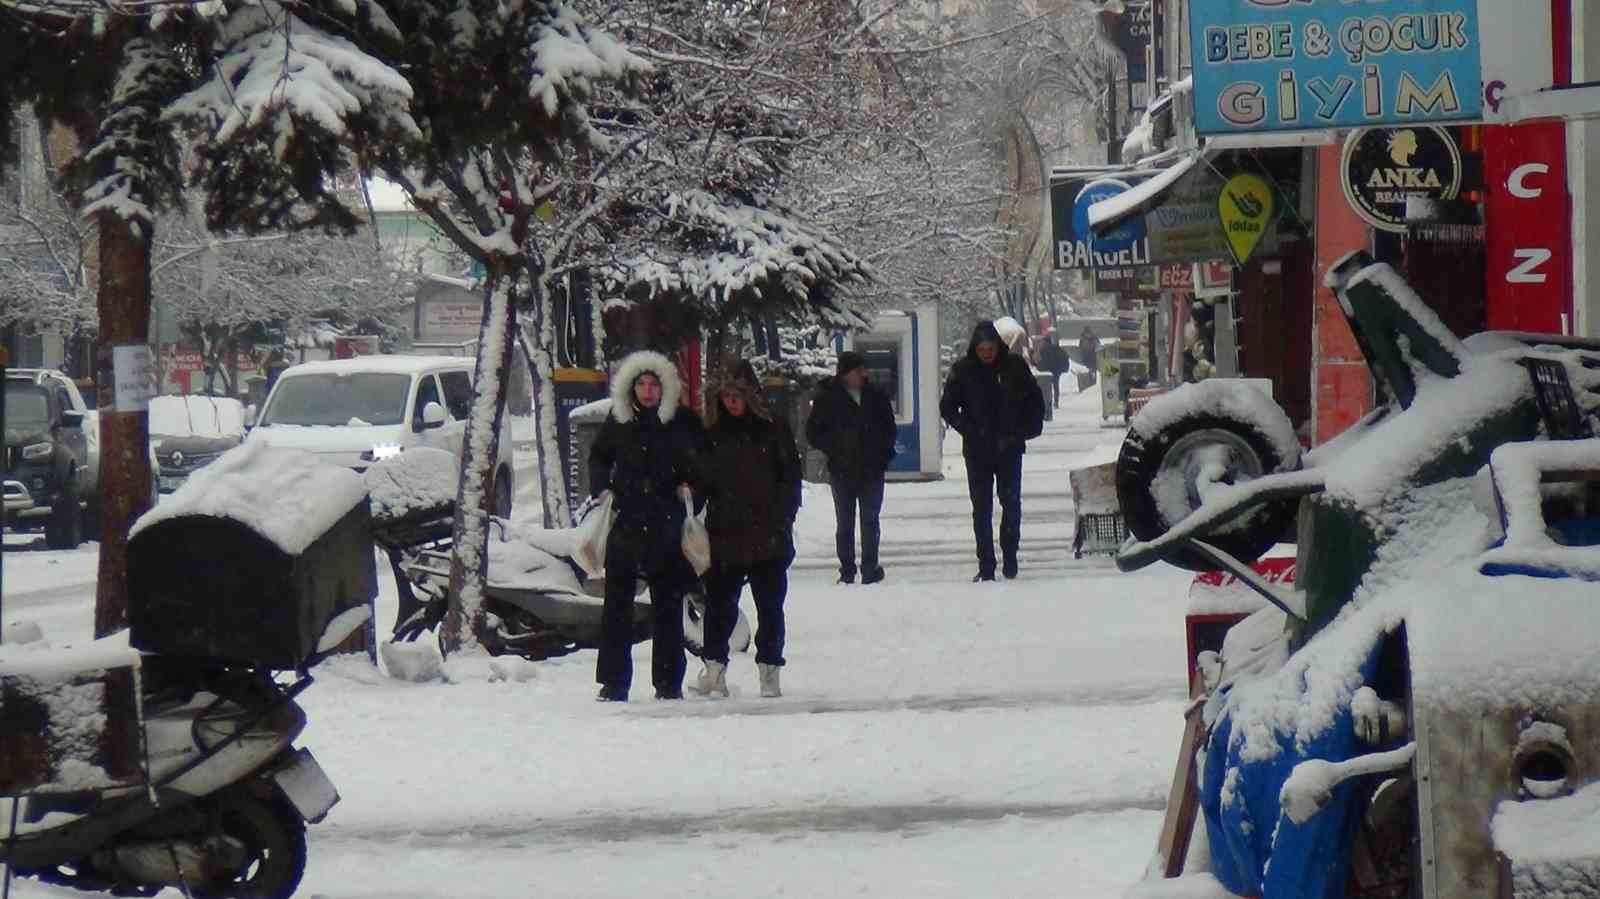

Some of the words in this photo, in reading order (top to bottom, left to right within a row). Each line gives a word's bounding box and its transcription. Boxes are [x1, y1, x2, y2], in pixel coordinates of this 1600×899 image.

[1206, 23, 1294, 63] BEBE
[1304, 20, 1332, 56] &
[1338, 14, 1467, 64] ÇOCUK
[1218, 64, 1458, 125] GİYİM
[1366, 167, 1442, 188] ANKA
